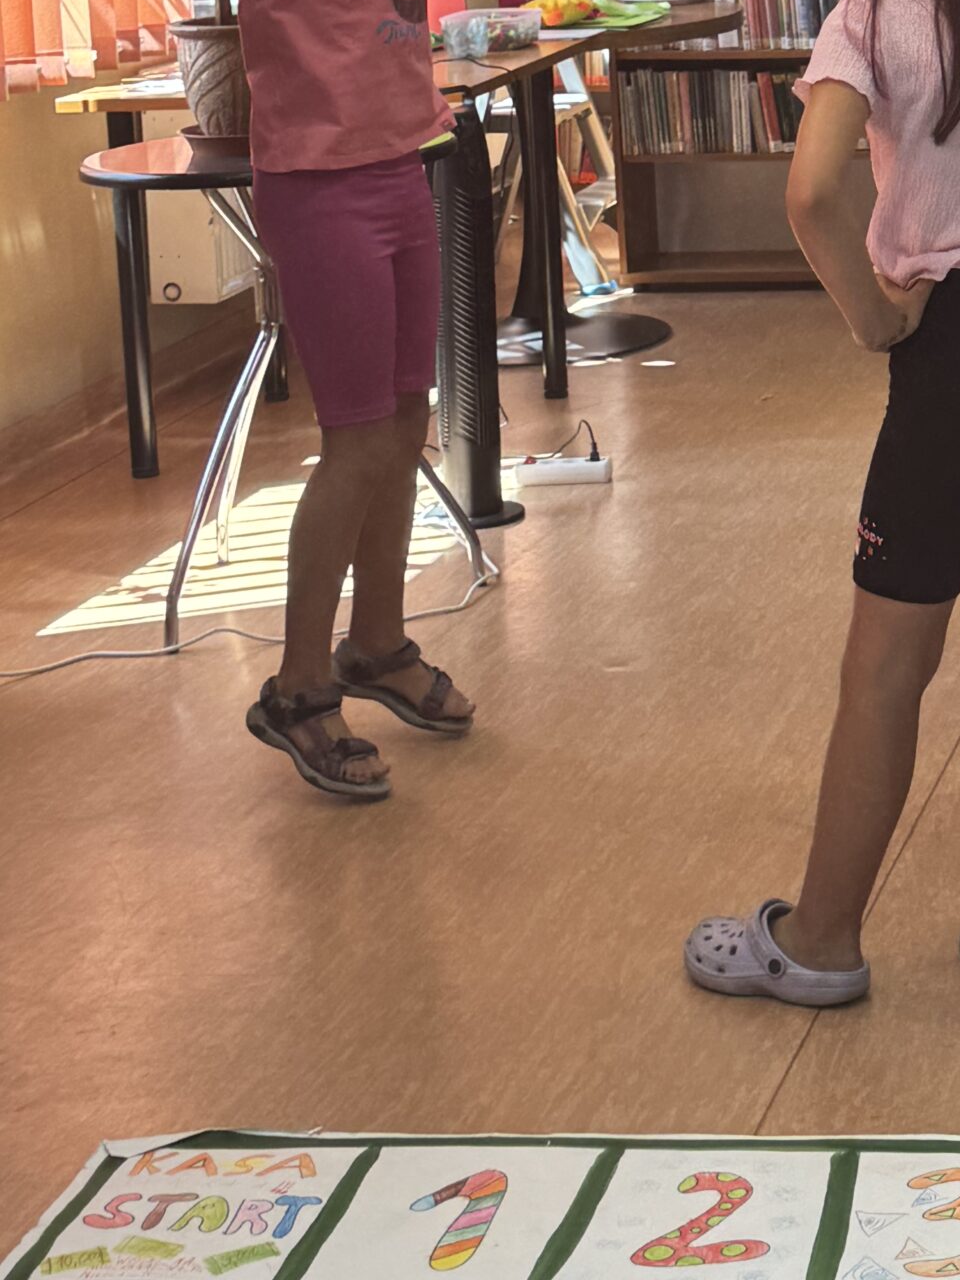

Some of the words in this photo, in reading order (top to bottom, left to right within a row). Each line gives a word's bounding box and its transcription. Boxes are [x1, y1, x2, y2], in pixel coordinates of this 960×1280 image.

[128, 1151, 318, 1179] KASA
[82, 1192, 323, 1239] START
[409, 1169, 508, 1271] 1
[630, 1171, 771, 1267] 2
